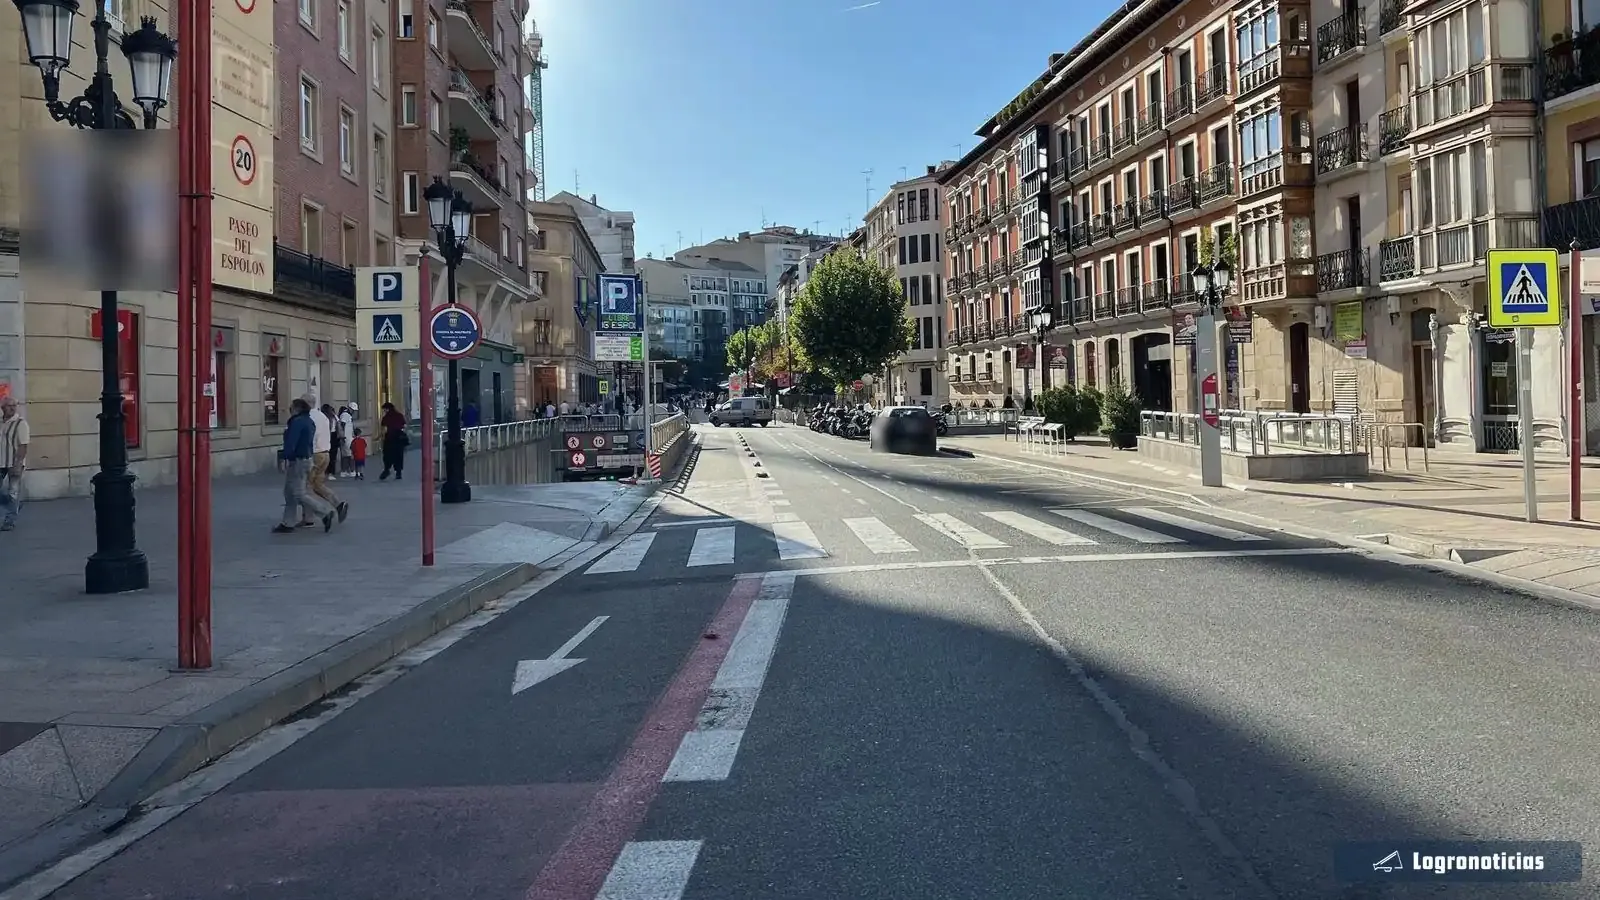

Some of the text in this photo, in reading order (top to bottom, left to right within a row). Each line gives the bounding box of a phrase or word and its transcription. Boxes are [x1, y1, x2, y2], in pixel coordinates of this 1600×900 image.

[235, 148, 252, 172] 20
[228, 216, 259, 238] PASEO
[234, 237, 254, 255] DEL
[377, 274, 397, 299] P
[609, 283, 628, 309] P
[595, 438, 604, 446] 10
